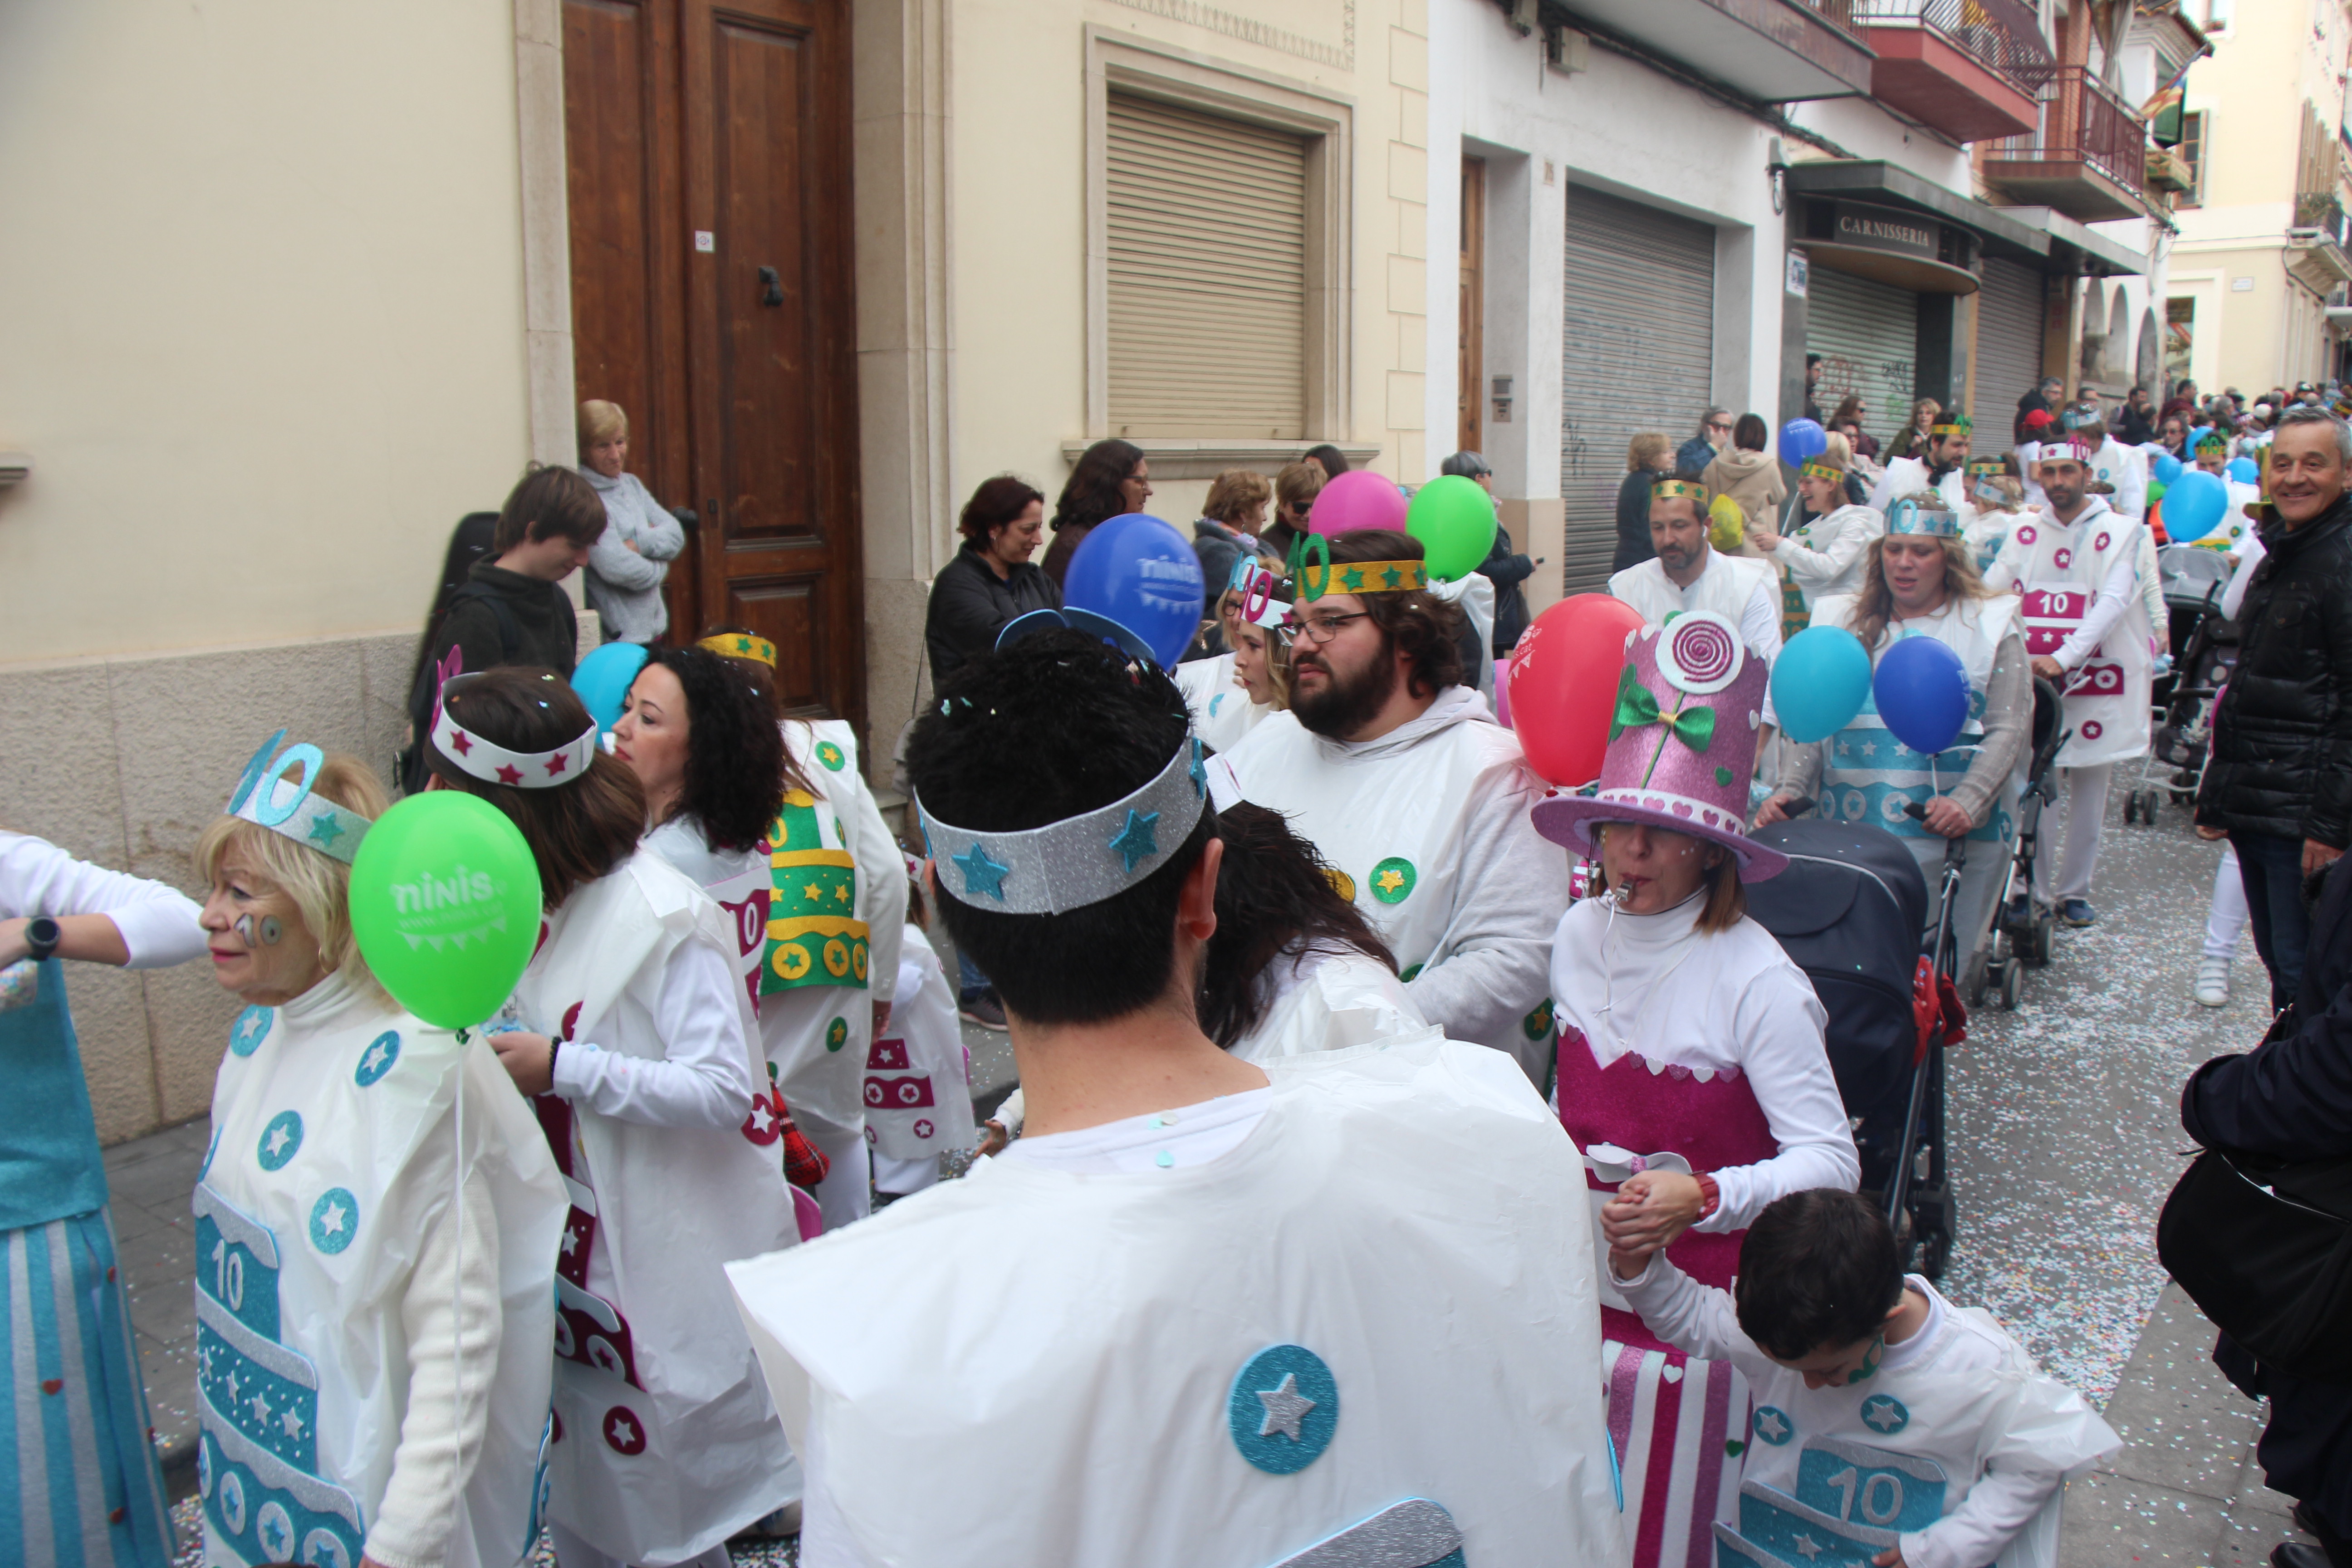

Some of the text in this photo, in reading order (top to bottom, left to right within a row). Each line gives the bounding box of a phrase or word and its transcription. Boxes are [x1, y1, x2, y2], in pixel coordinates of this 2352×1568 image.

[1840, 216, 1929, 246] CARNISSERIA
[1886, 497, 1917, 534] 10
[1239, 564, 1272, 622] 10
[1285, 531, 1330, 603] 10
[2039, 593, 2068, 614] 10
[228, 729, 324, 826] 10
[234, 913, 282, 948] 10
[212, 1239, 243, 1311] 10
[1827, 1466, 1902, 1525] 10
